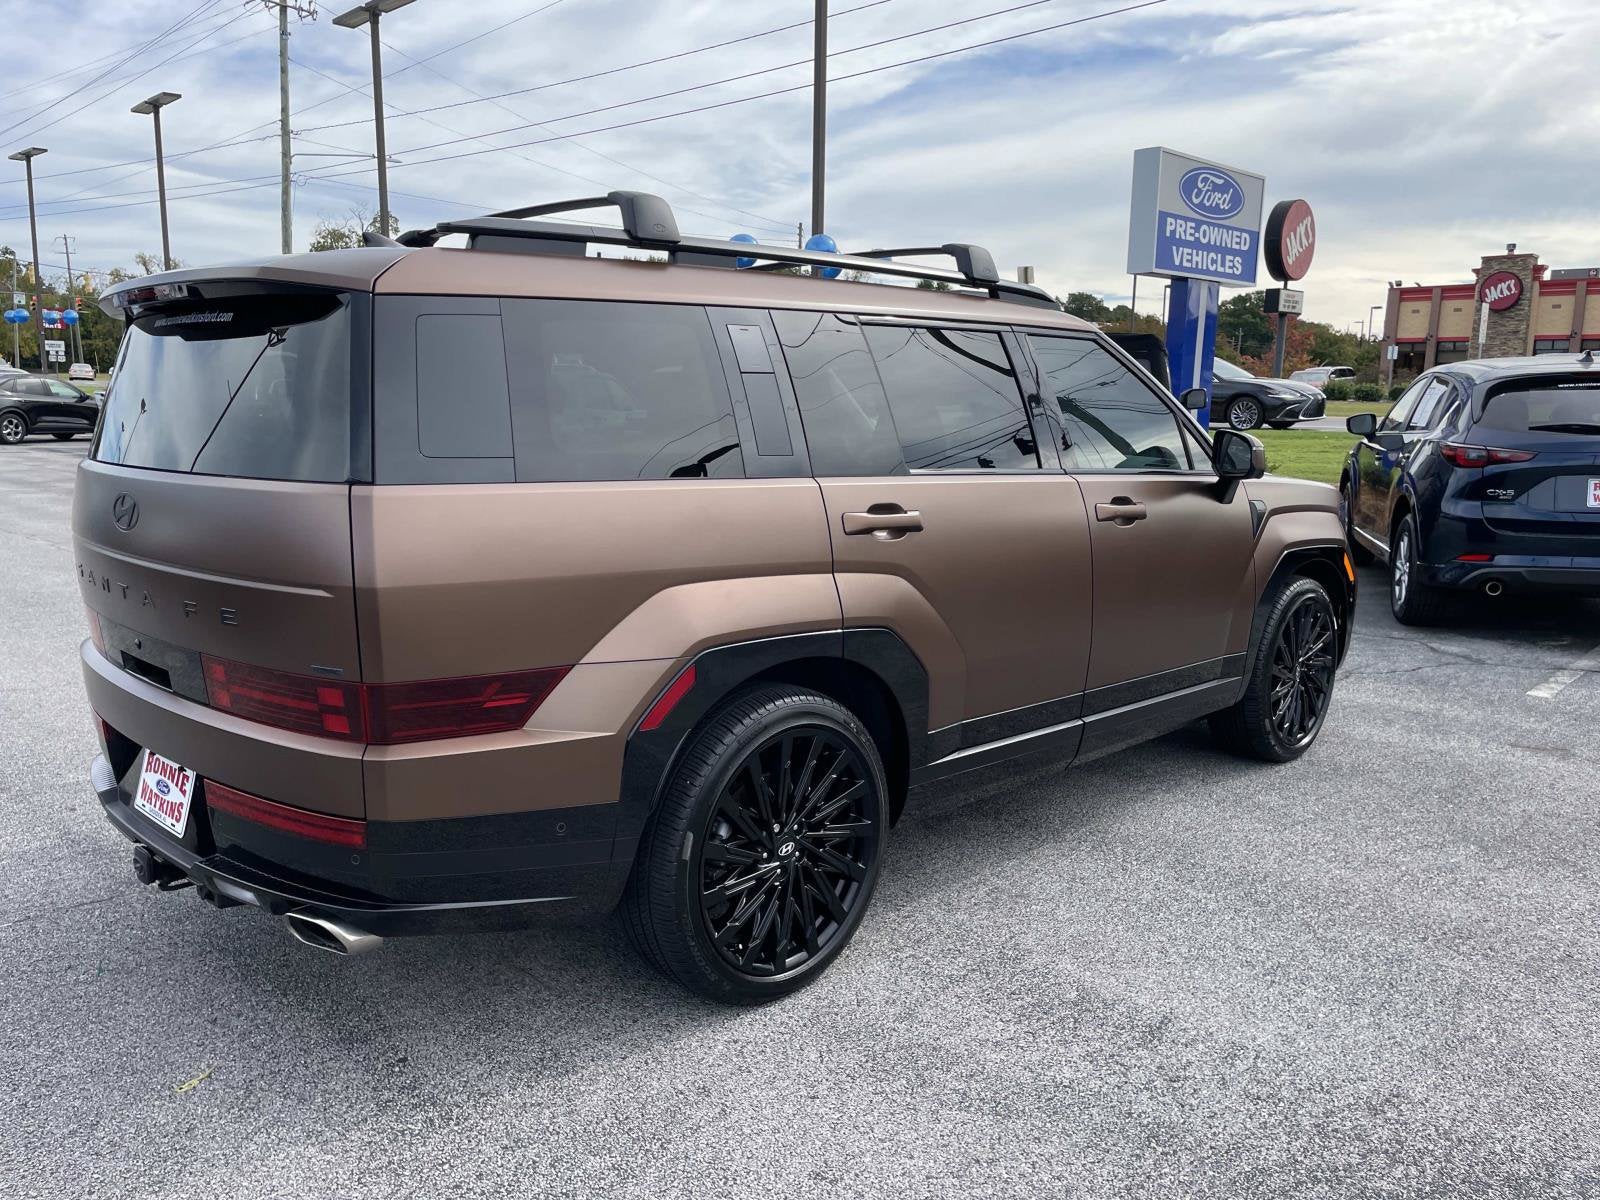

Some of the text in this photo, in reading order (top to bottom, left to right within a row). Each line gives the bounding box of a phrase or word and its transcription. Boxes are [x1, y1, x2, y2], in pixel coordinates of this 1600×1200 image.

[1191, 173, 1233, 210] Ford
[1165, 217, 1250, 251] PRE-OWNED
[1172, 246, 1242, 275] VEHICLES
[183, 600, 238, 625] FE
[145, 752, 190, 798] RONNIE
[141, 778, 185, 824] WATKINS
